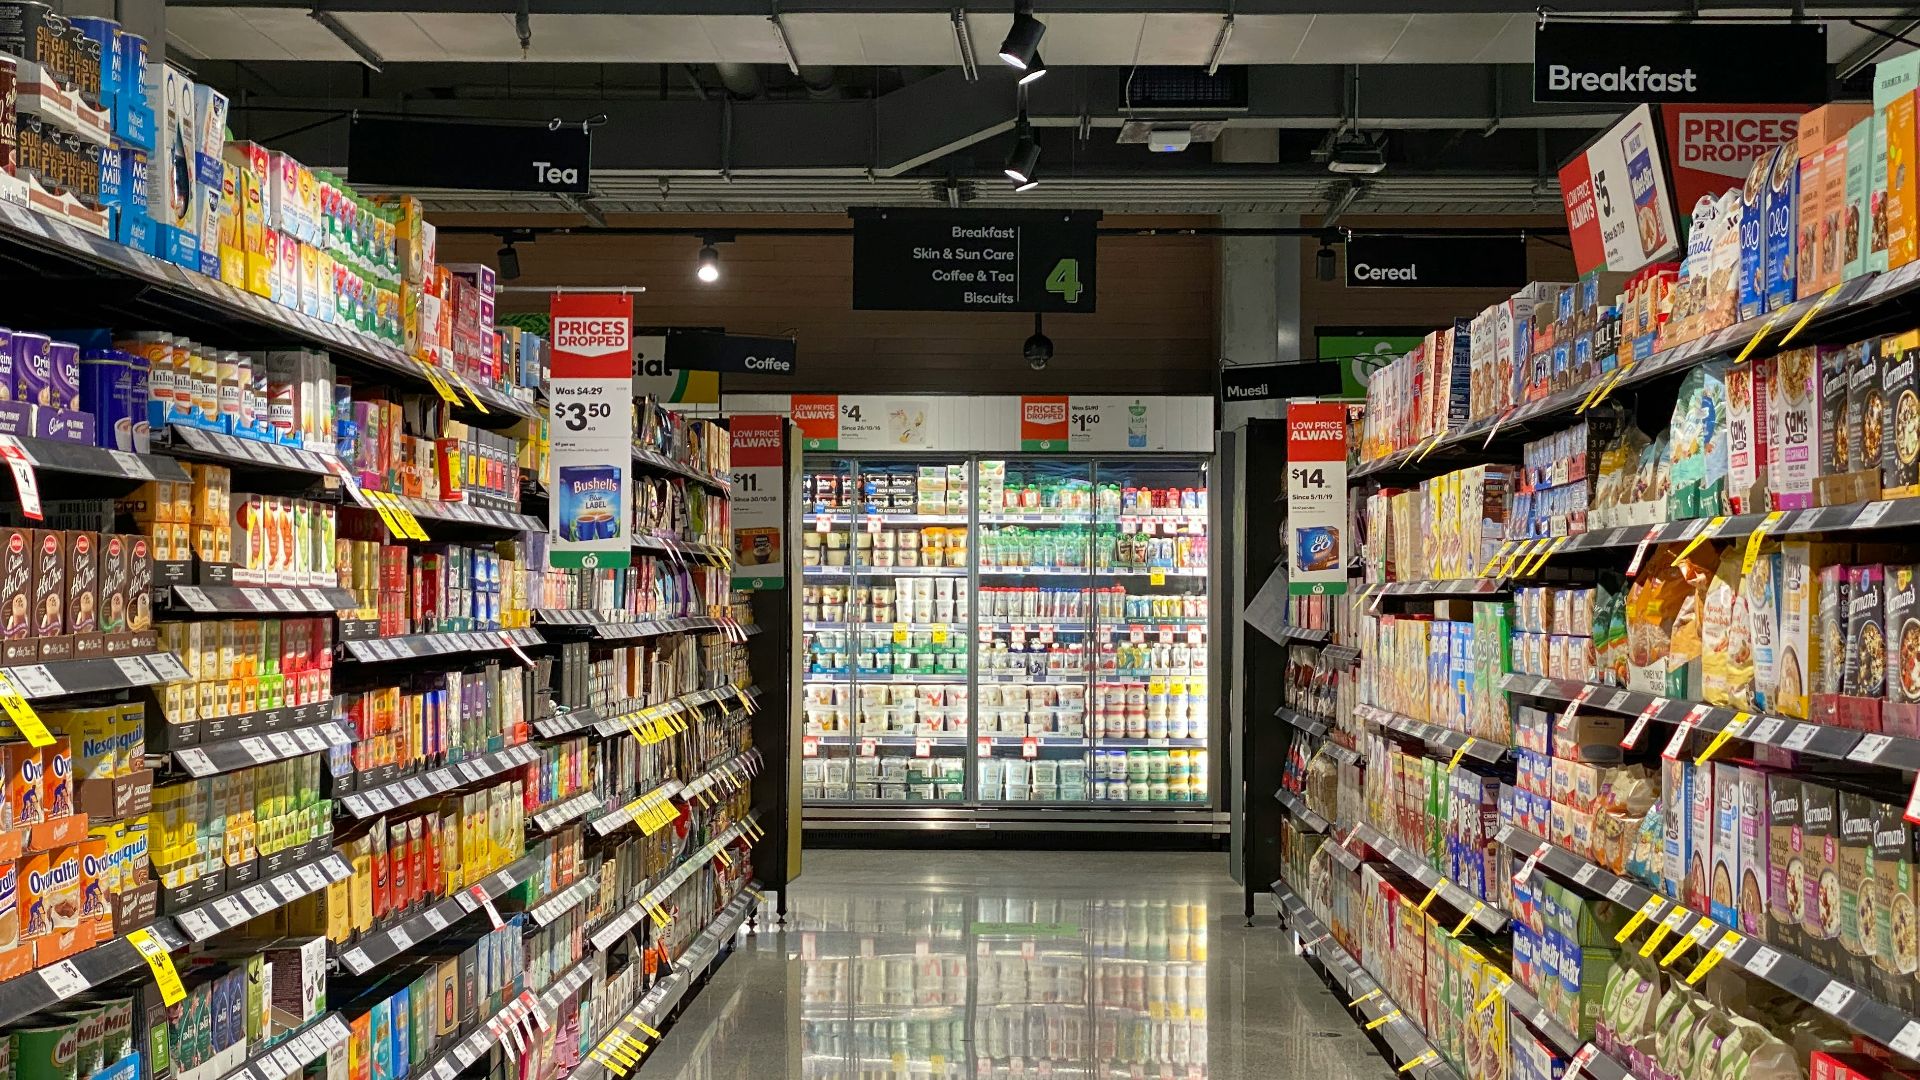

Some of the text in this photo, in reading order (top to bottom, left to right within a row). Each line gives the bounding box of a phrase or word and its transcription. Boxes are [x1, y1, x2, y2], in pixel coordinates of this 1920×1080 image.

[1549, 64, 1697, 92] Breakfast
[1684, 119, 1799, 143] PRICES
[532, 161, 578, 184] Tea
[1567, 179, 1591, 208] LOW PRICE
[1570, 198, 1596, 231] ALWAYS
[952, 226, 1015, 239] Breakfast
[913, 248, 1015, 260] Skin & Sun Care
[932, 270, 1015, 282] Coffee & Tea
[1354, 263, 1417, 281] Cereal
[1045, 258, 1083, 304] 4
[963, 292, 1014, 304] Biscuits
[558, 321, 625, 335] PRICES
[557, 335, 625, 347] DROPPED
[744, 356, 790, 371] Coffee
[555, 386, 603, 396] Was $4.29
[1227, 384, 1268, 398] Muesli
[794, 411, 836, 420] ALWAYS
[841, 405, 862, 422] $4
[1026, 405, 1064, 413] PRICES
[1291, 421, 1343, 430] LOW PRICE
[733, 429, 780, 438] LOW PRICE
[1291, 430, 1344, 441] ALWAYS
[732, 438, 780, 448] ALWAYS
[573, 477, 618, 494] Bushells
[733, 473, 757, 491] $11
[1292, 468, 1325, 489] $14
[585, 501, 607, 509] LABEL
